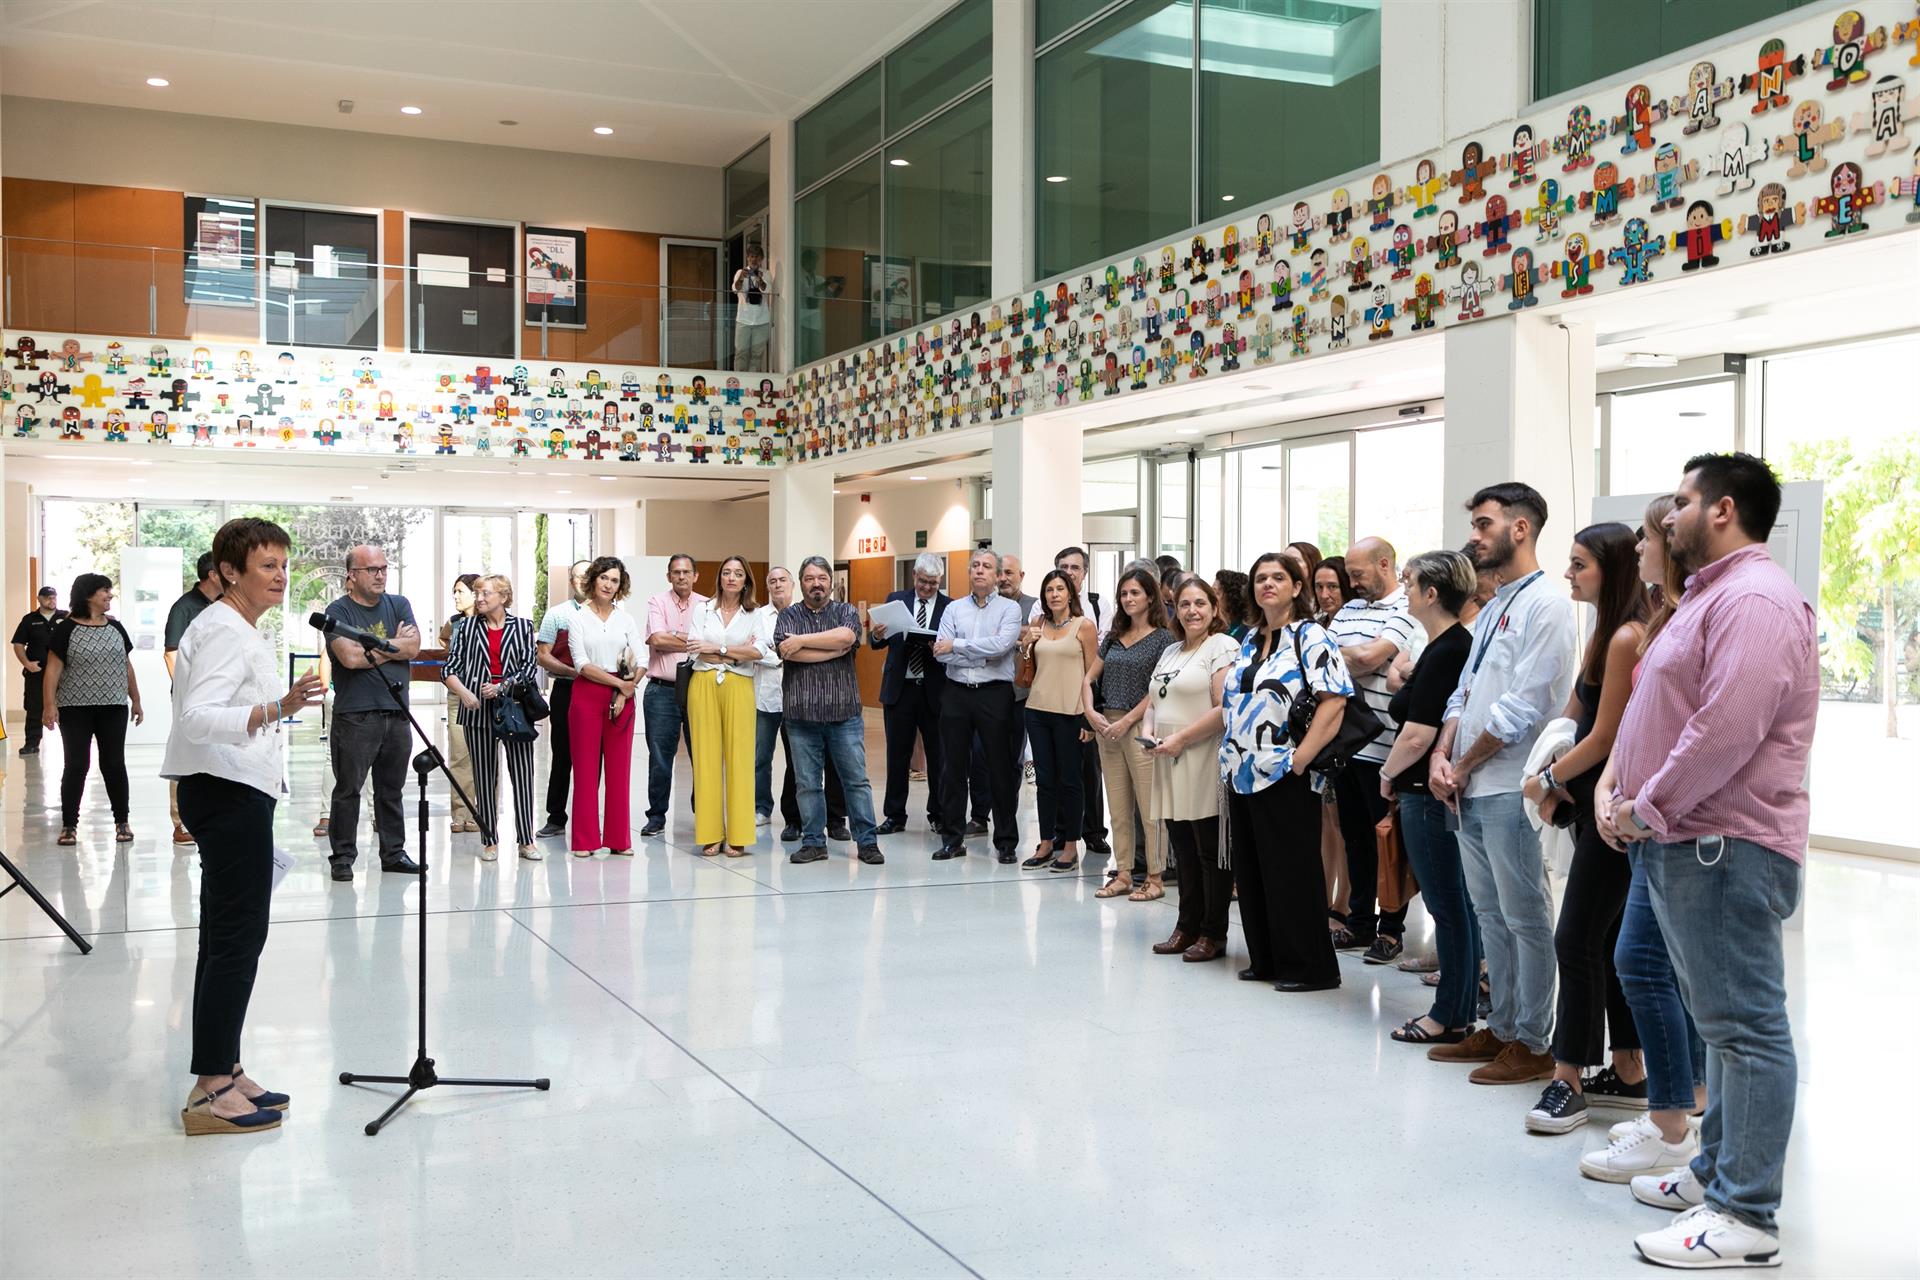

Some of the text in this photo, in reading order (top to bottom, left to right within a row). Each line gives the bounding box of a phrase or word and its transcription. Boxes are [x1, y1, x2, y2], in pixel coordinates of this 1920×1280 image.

[1517, 149, 1534, 176] E
[1569, 130, 1585, 156] M
[1634, 106, 1644, 132] L
[1692, 88, 1709, 118] A
[1760, 65, 1782, 99] N
[1838, 42, 1860, 73] O
[1596, 189, 1615, 215] M
[1660, 174, 1673, 198] E
[1723, 147, 1745, 177] M
[1798, 132, 1815, 162] L
[1876, 106, 1897, 141] A
[1332, 315, 1345, 338] N
[1465, 286, 1477, 310] A
[1627, 242, 1642, 268] T
[1758, 211, 1781, 243] M
[1838, 194, 1853, 225] E
